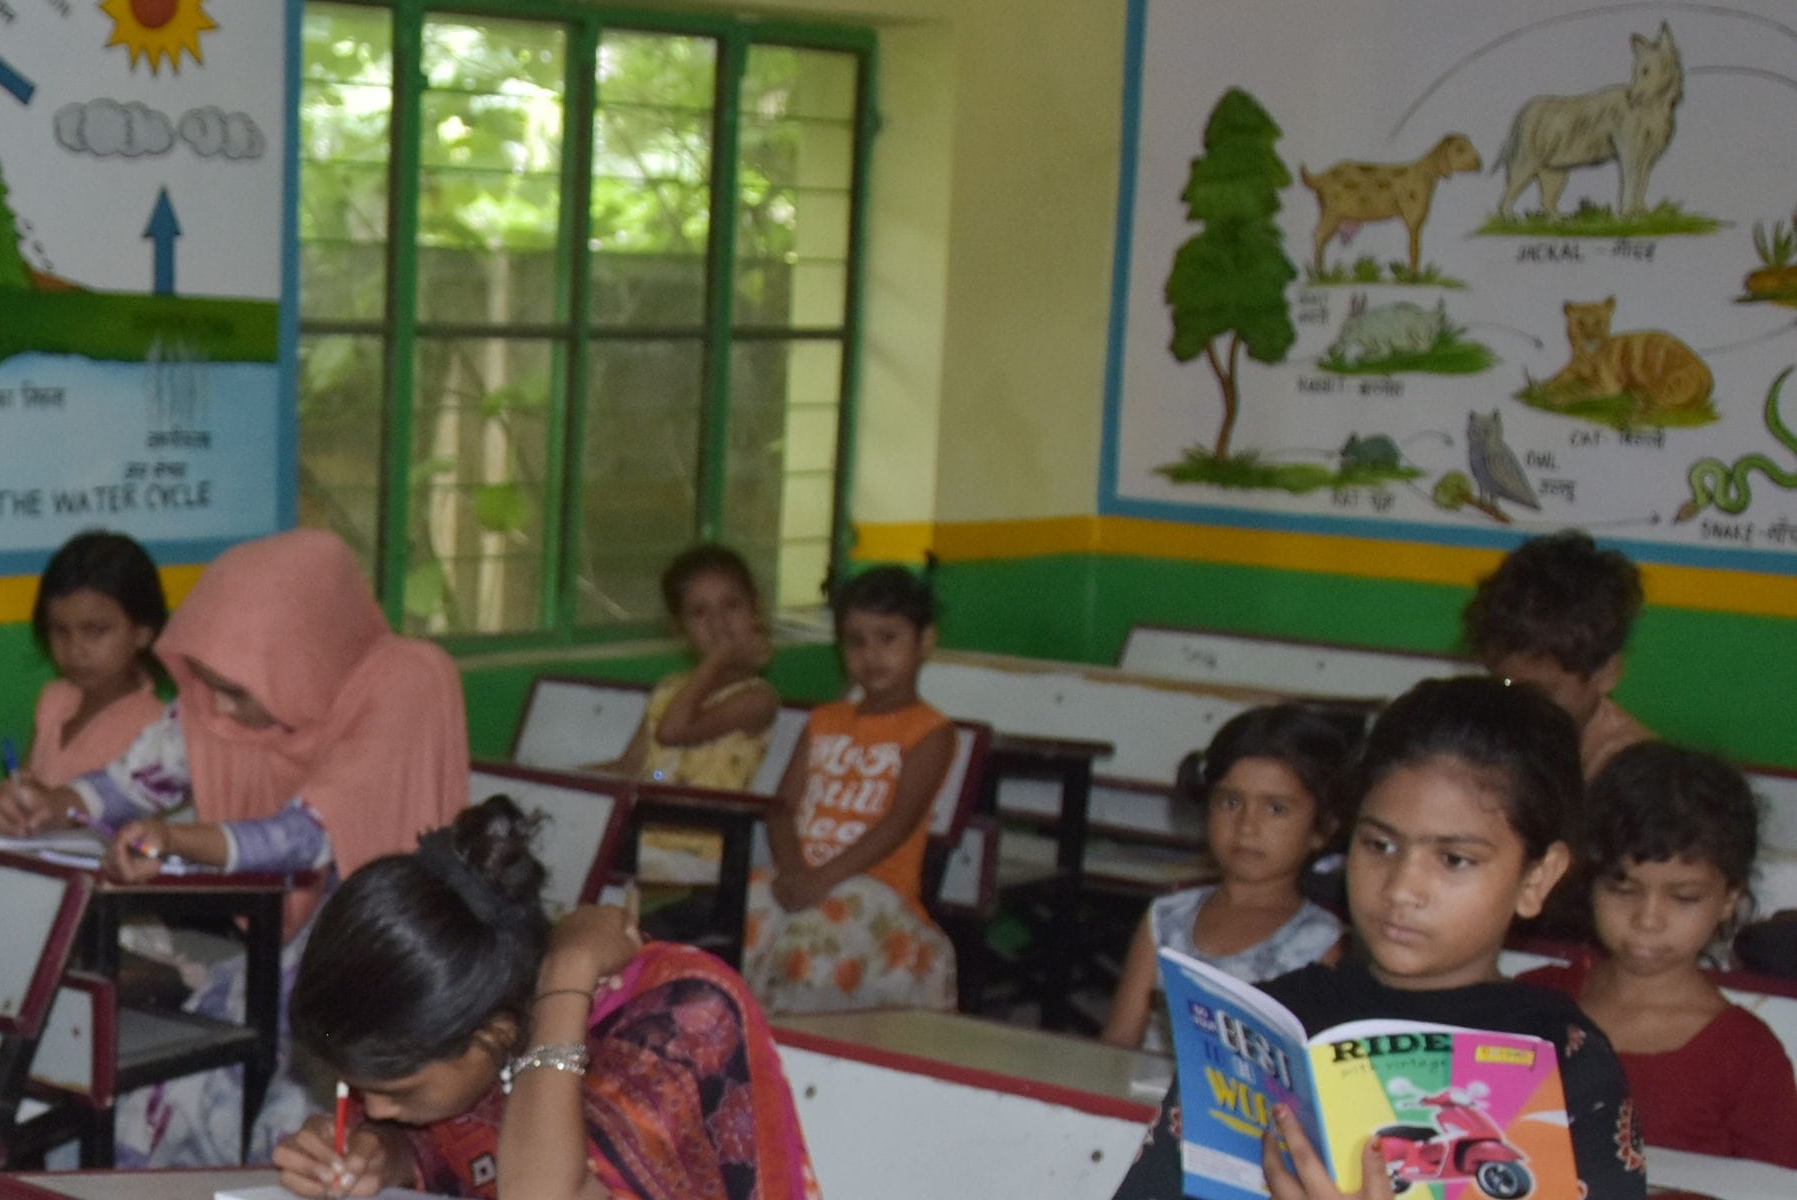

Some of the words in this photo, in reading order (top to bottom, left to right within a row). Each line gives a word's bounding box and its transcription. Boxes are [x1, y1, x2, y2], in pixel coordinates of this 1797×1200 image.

[53, 484, 139, 513] WATER
[144, 479, 211, 510] CYCLE
[1329, 1033, 1454, 1063] RIDE
